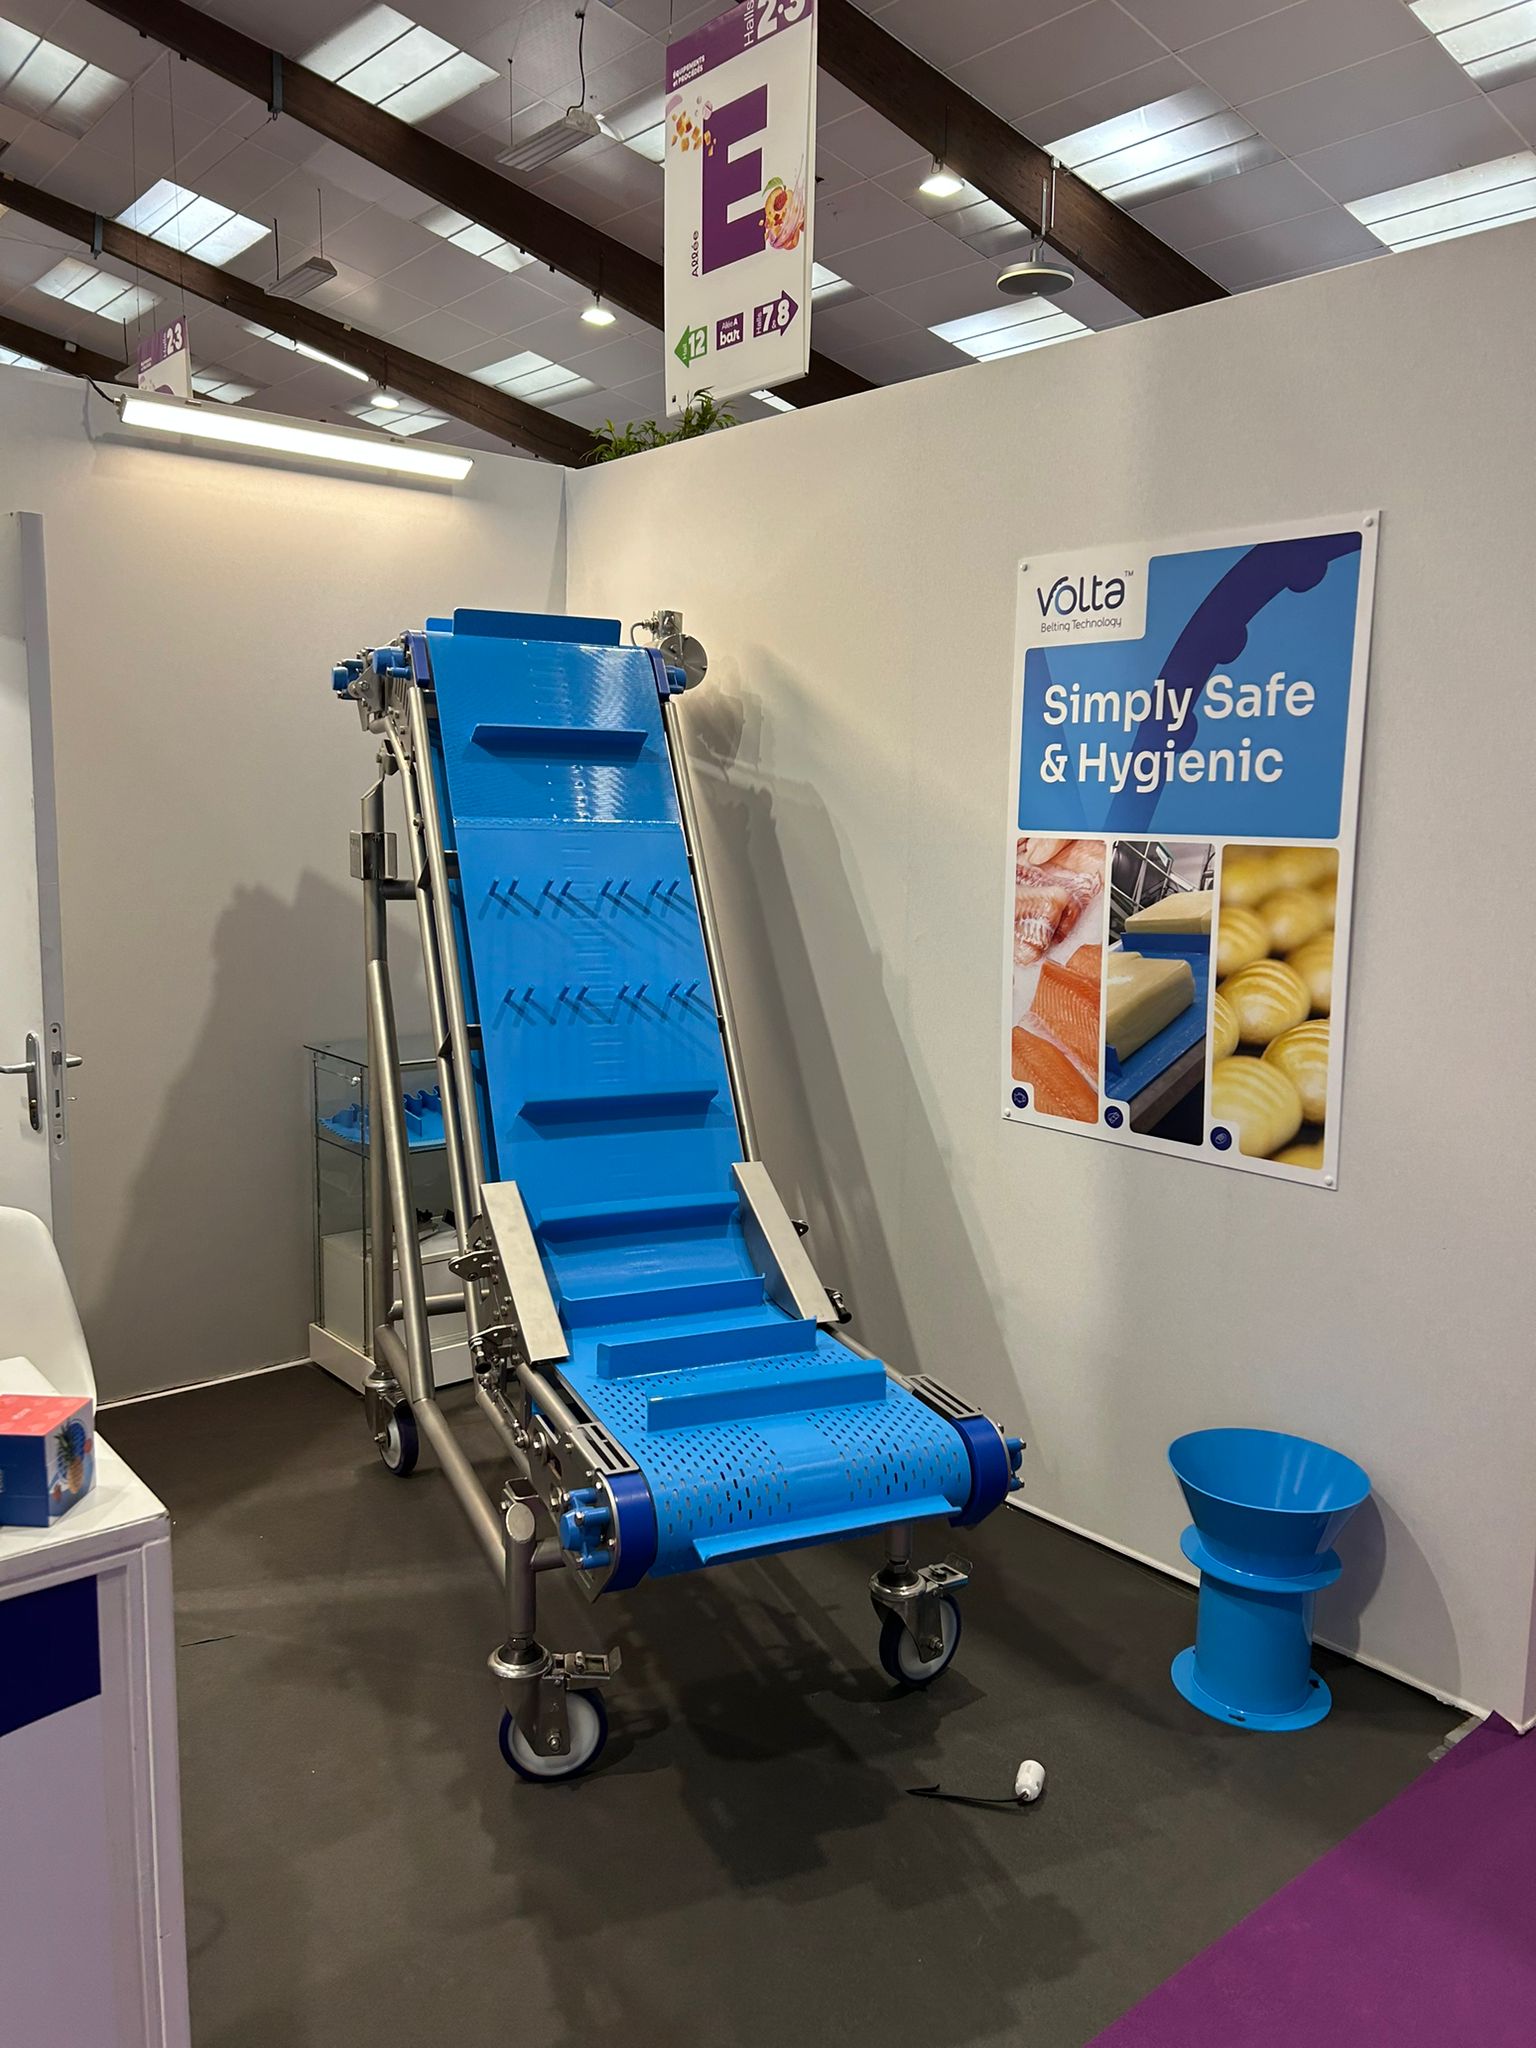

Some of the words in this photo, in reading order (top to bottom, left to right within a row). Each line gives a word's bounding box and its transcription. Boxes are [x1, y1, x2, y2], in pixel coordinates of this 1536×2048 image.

[702, 84, 768, 275] E
[762, 303, 774, 333] 7
[777, 299, 790, 326] 8
[688, 329, 706, 358] 12
[1040, 621, 1070, 633] Belting
[1072, 616, 1122, 630] Technology
[1043, 679, 1193, 732] Simply
[1203, 672, 1315, 719] Safe
[1040, 743, 1068, 783] &
[1078, 737, 1284, 794] Hygienic
